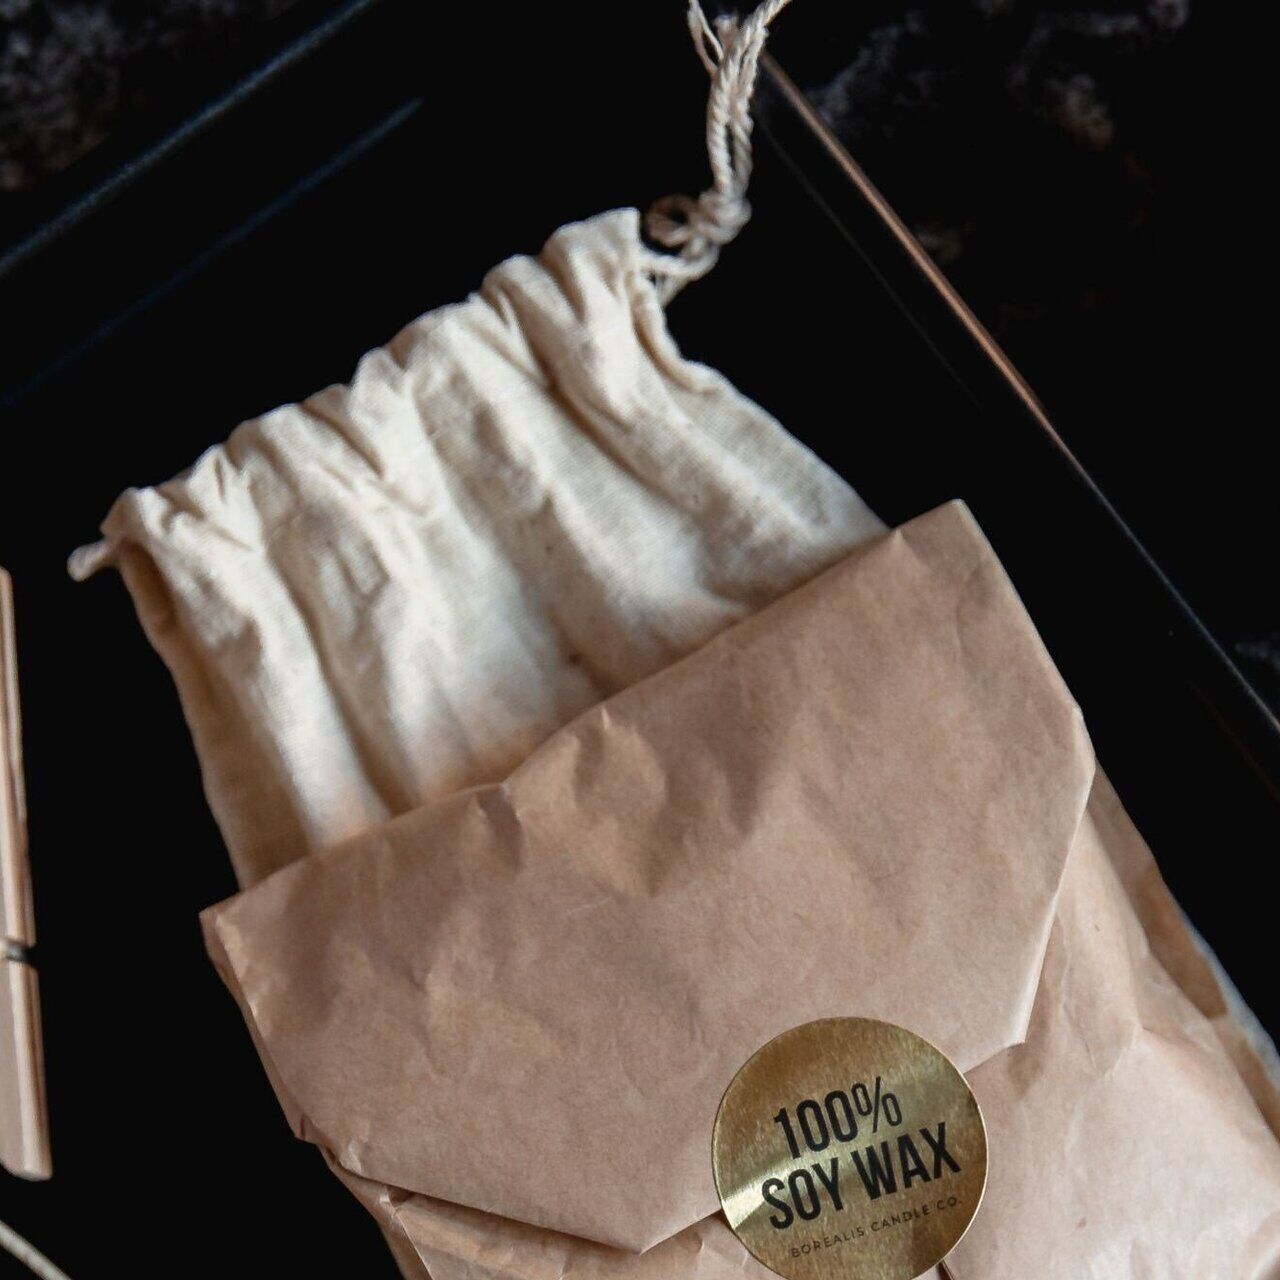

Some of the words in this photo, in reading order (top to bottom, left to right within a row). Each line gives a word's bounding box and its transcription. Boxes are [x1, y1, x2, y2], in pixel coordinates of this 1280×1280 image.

[772, 1076, 903, 1160] 100%
[761, 1157, 844, 1230] SOY
[850, 1121, 962, 1201] WAX
[791, 1227, 865, 1258] BOREALIS
[870, 1204, 931, 1232] CANDLE
